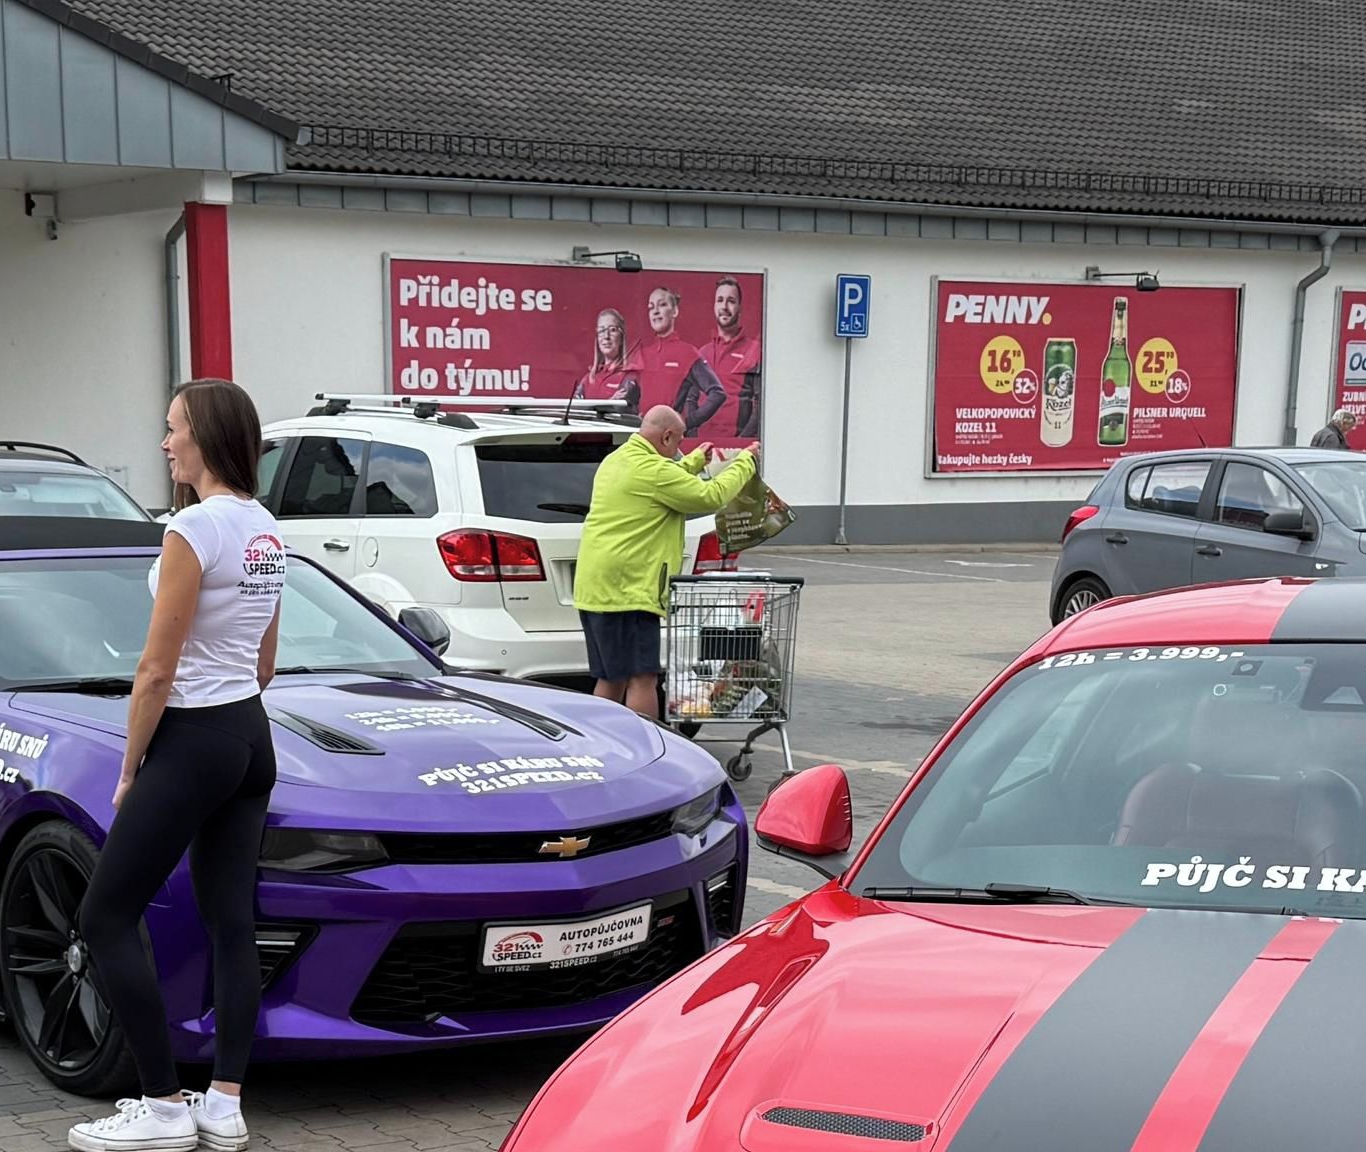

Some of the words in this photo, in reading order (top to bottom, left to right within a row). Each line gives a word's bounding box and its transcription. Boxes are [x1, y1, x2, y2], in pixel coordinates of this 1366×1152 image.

[399, 274, 515, 315] Přidejte
[521, 288, 552, 311] se
[844, 283, 863, 317] P
[399, 318, 419, 347] k
[425, 317, 490, 349] nám
[400, 360, 438, 389] do
[445, 359, 530, 396] týmu!
[956, 405, 1036, 419] VELKOPOPOVICKÝ
[1133, 407, 1167, 418] PILSNER
[1169, 407, 1206, 420] URQUELL
[955, 422, 983, 433] KOZEL
[985, 422, 997, 432] 11
[982, 454, 1008, 466] hezky
[1009, 453, 1033, 466] česky
[1038, 652, 1095, 670] 12h
[1128, 646, 1244, 662] 3.999,-
[16, 734, 49, 759] SNŮ
[476, 761, 505, 775] SI
[461, 771, 605, 794] 321SPEED.cz
[1140, 855, 1255, 893] PŮJČ
[1262, 863, 1311, 890] SI
[559, 915, 643, 942] AUTOPŮJČOVNA
[493, 943, 519, 953] 321
[575, 942, 594, 953] 774
[597, 936, 614, 948] 765
[617, 931, 634, 943] 444
